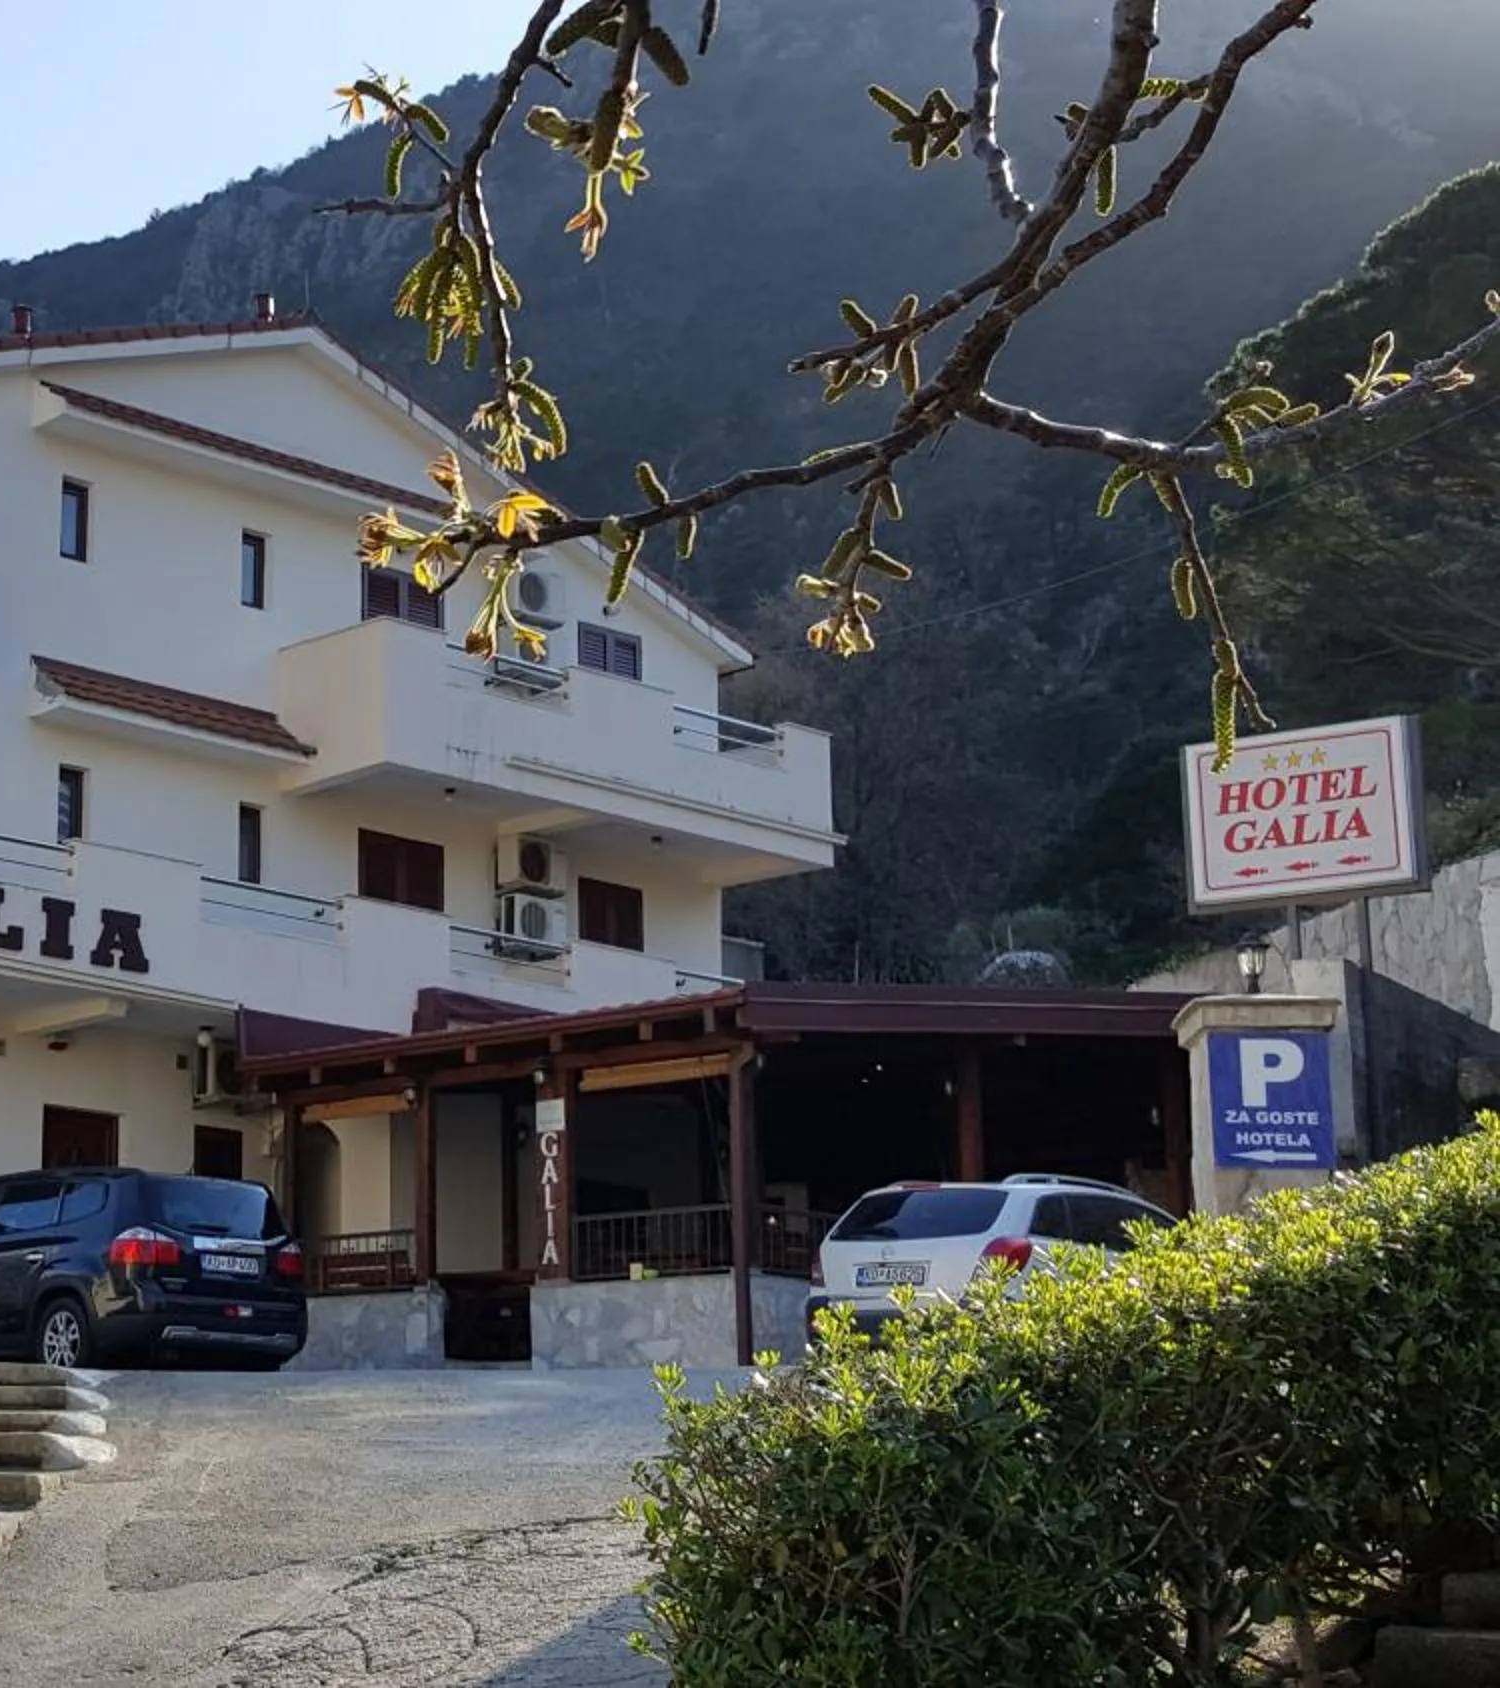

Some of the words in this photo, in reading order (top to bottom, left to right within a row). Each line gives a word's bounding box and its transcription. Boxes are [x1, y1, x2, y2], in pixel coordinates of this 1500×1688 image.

[1216, 765, 1377, 816] HOTEL
[1223, 807, 1371, 854] GALIA
[1239, 1038, 1304, 1107] P
[1224, 1110, 1249, 1124] ZA
[1255, 1111, 1319, 1125] GOSTE
[1236, 1131, 1311, 1147] HOTELA
[540, 1131, 560, 1265] GALIA
